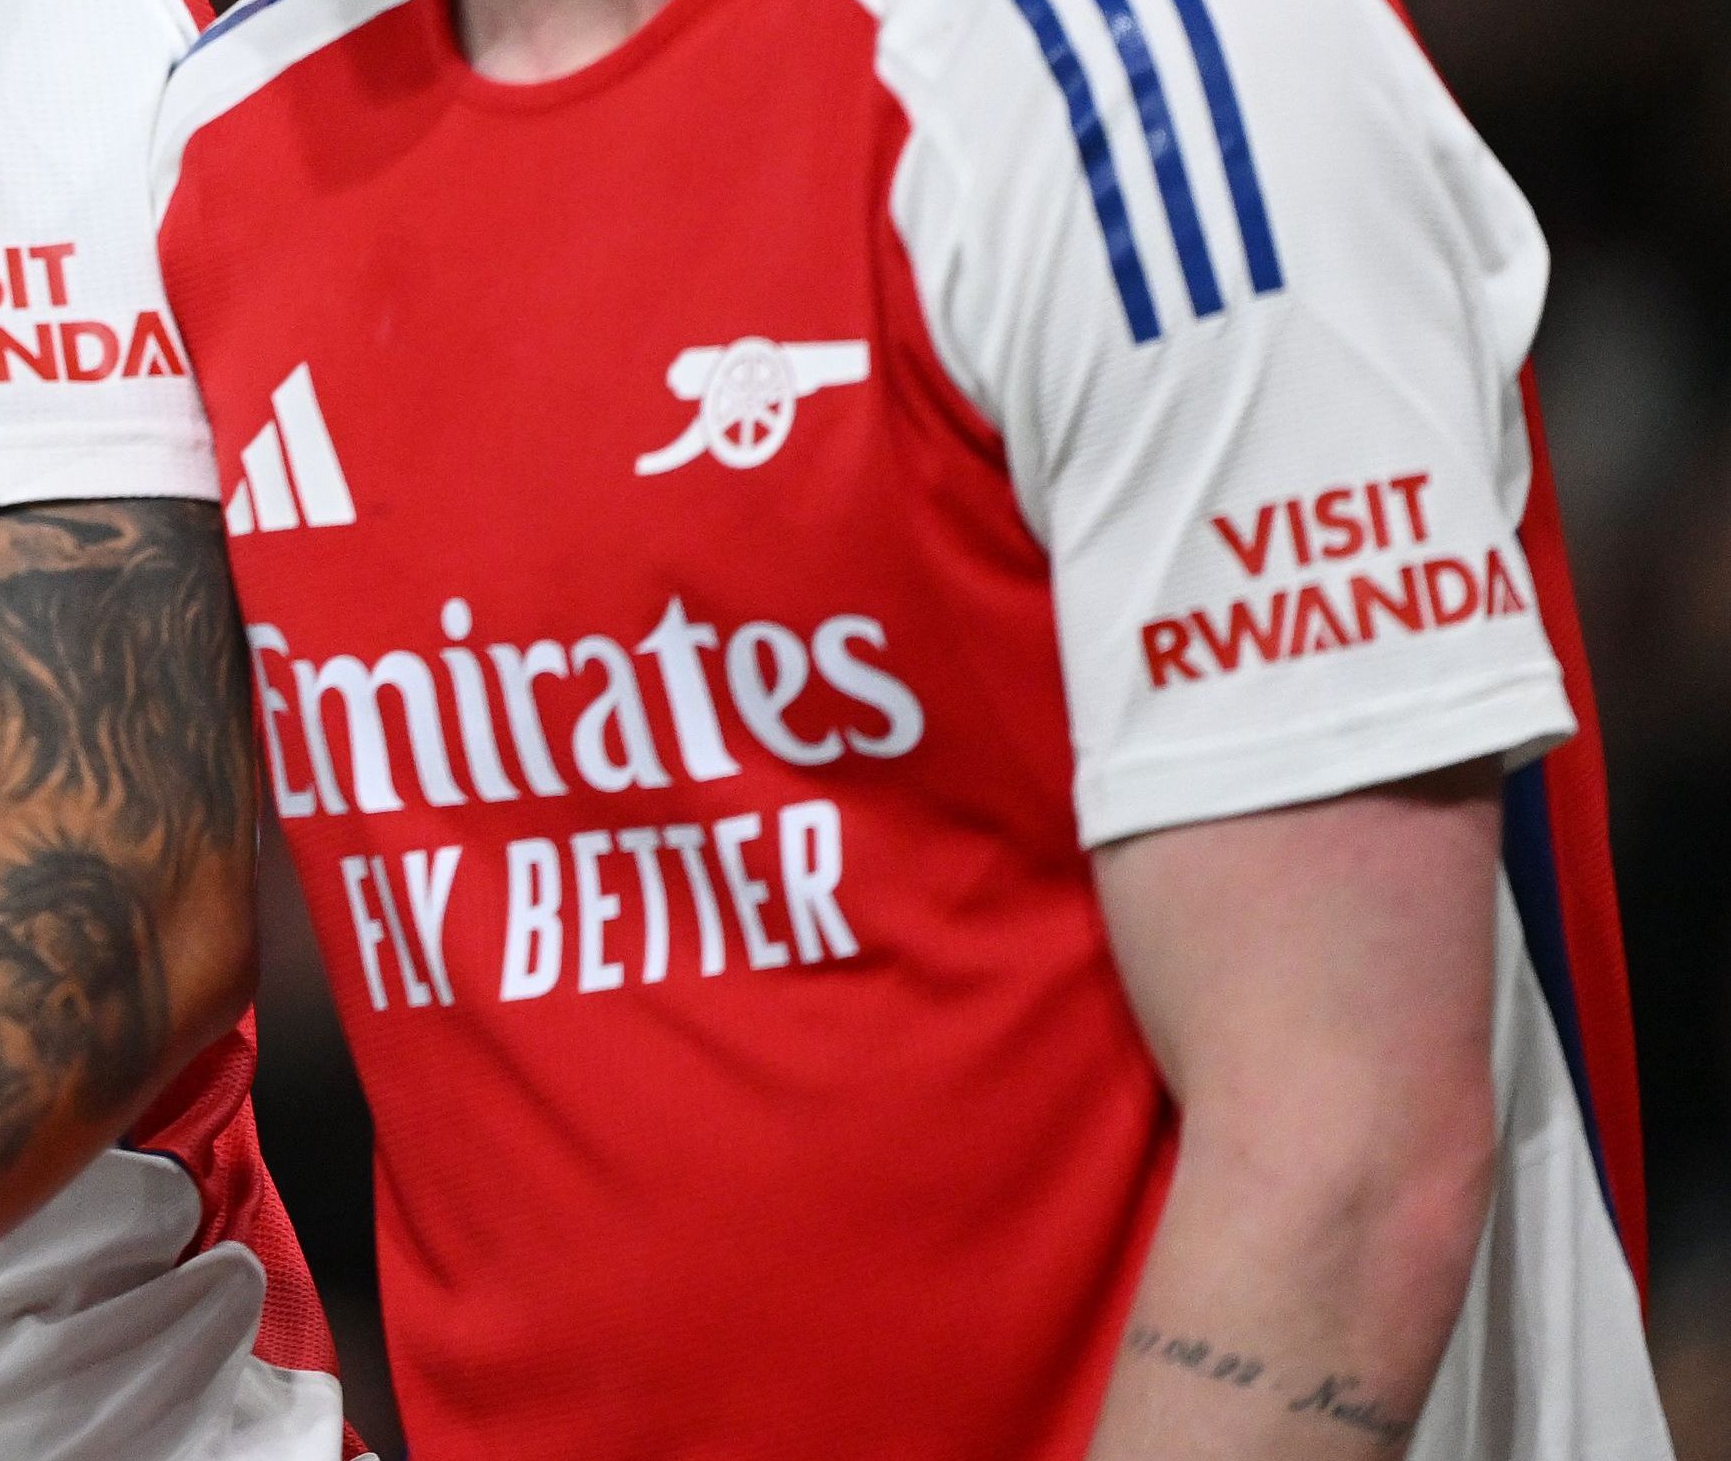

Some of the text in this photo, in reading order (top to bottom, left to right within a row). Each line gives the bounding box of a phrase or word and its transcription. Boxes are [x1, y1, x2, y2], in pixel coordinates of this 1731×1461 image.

[1210, 473, 1429, 577] VISIT
[1142, 548, 1525, 688] RWANDA
[246, 596, 925, 818] Emirates
[341, 799, 859, 1011] FLY BETTER
